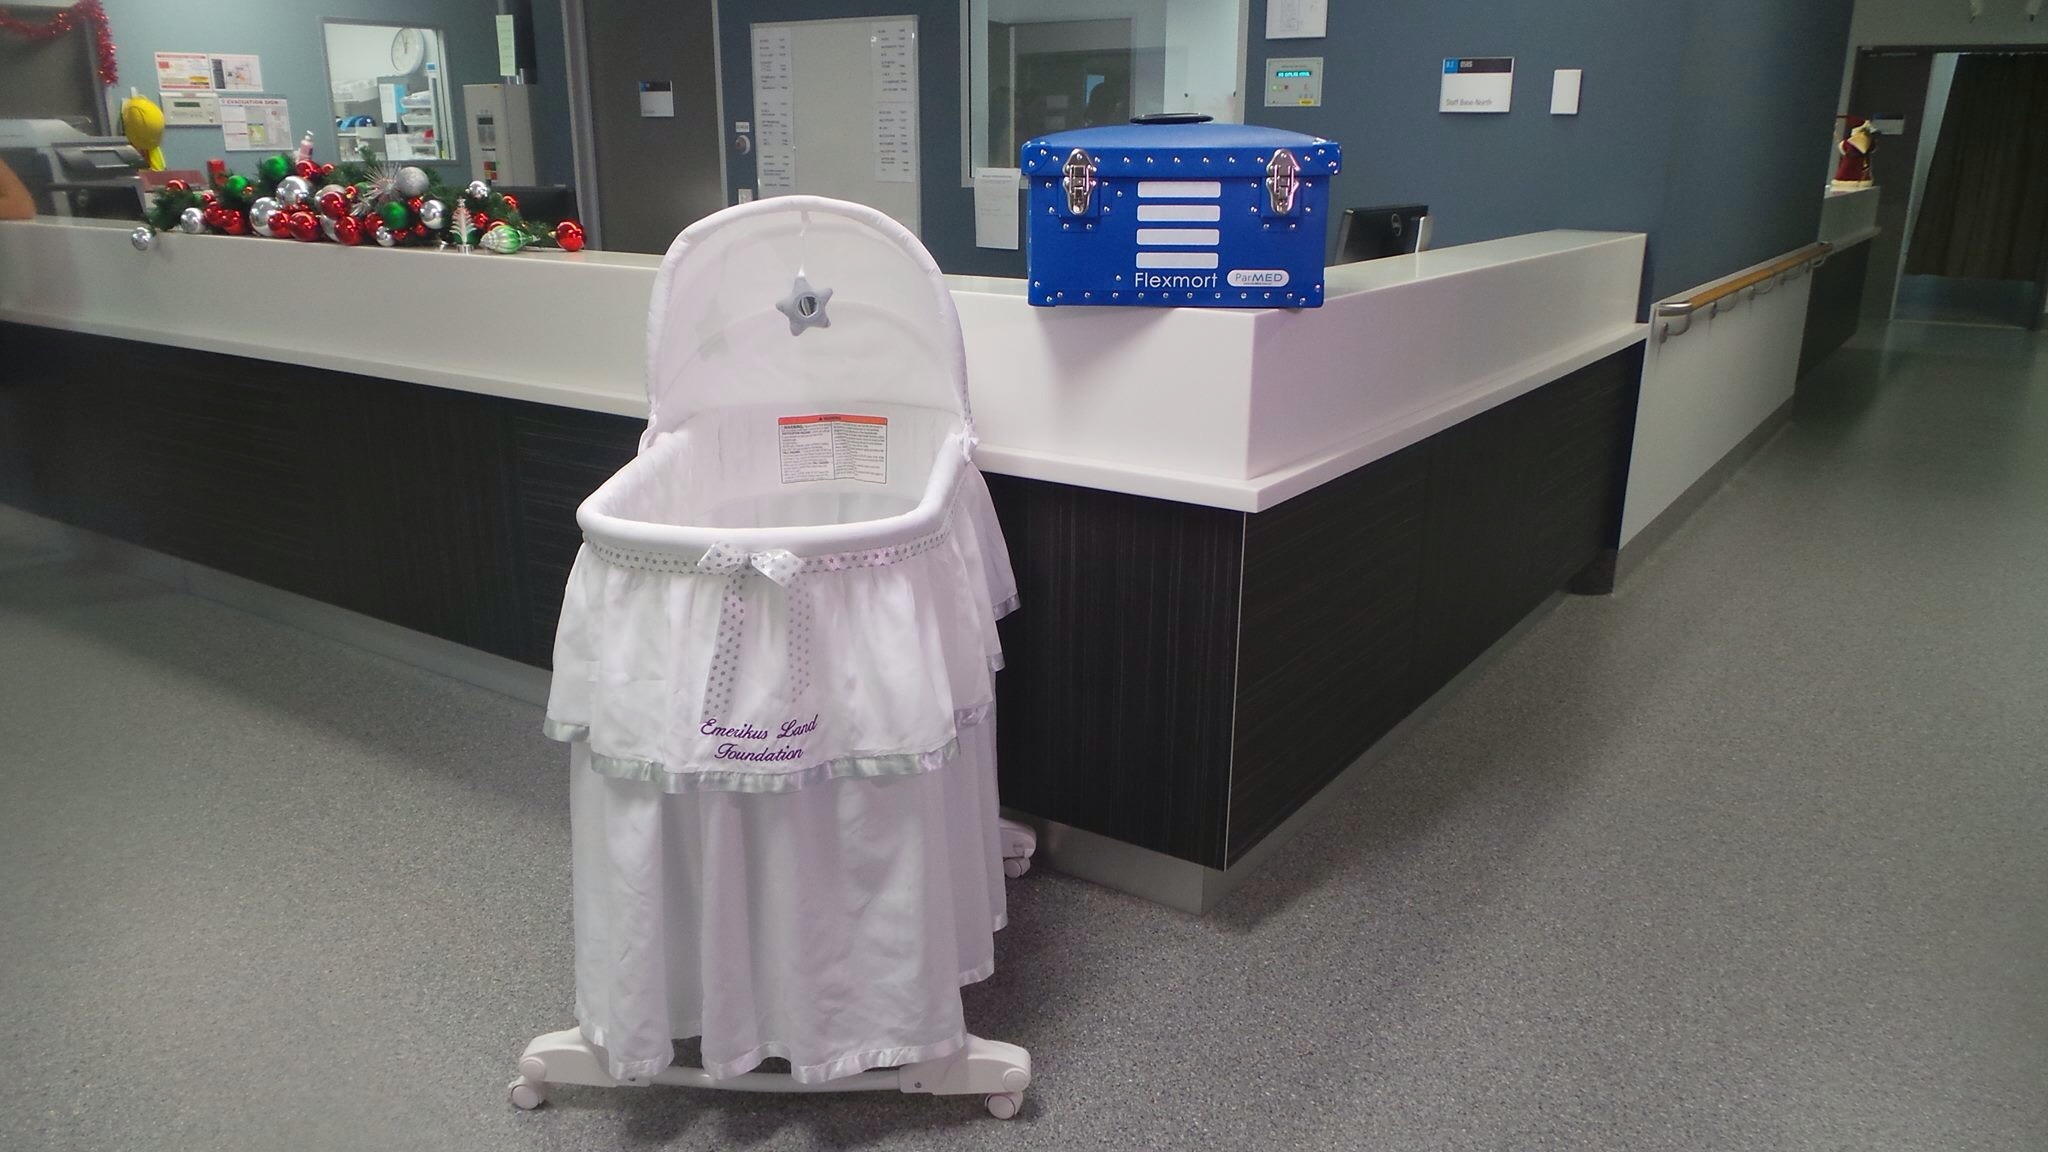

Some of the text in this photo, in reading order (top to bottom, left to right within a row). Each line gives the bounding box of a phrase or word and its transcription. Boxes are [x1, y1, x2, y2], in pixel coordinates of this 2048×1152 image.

[1135, 272, 1283, 288] Flexmort ParMED
[700, 714, 819, 740] Emerikus Land
[714, 743, 804, 762] Foundation
